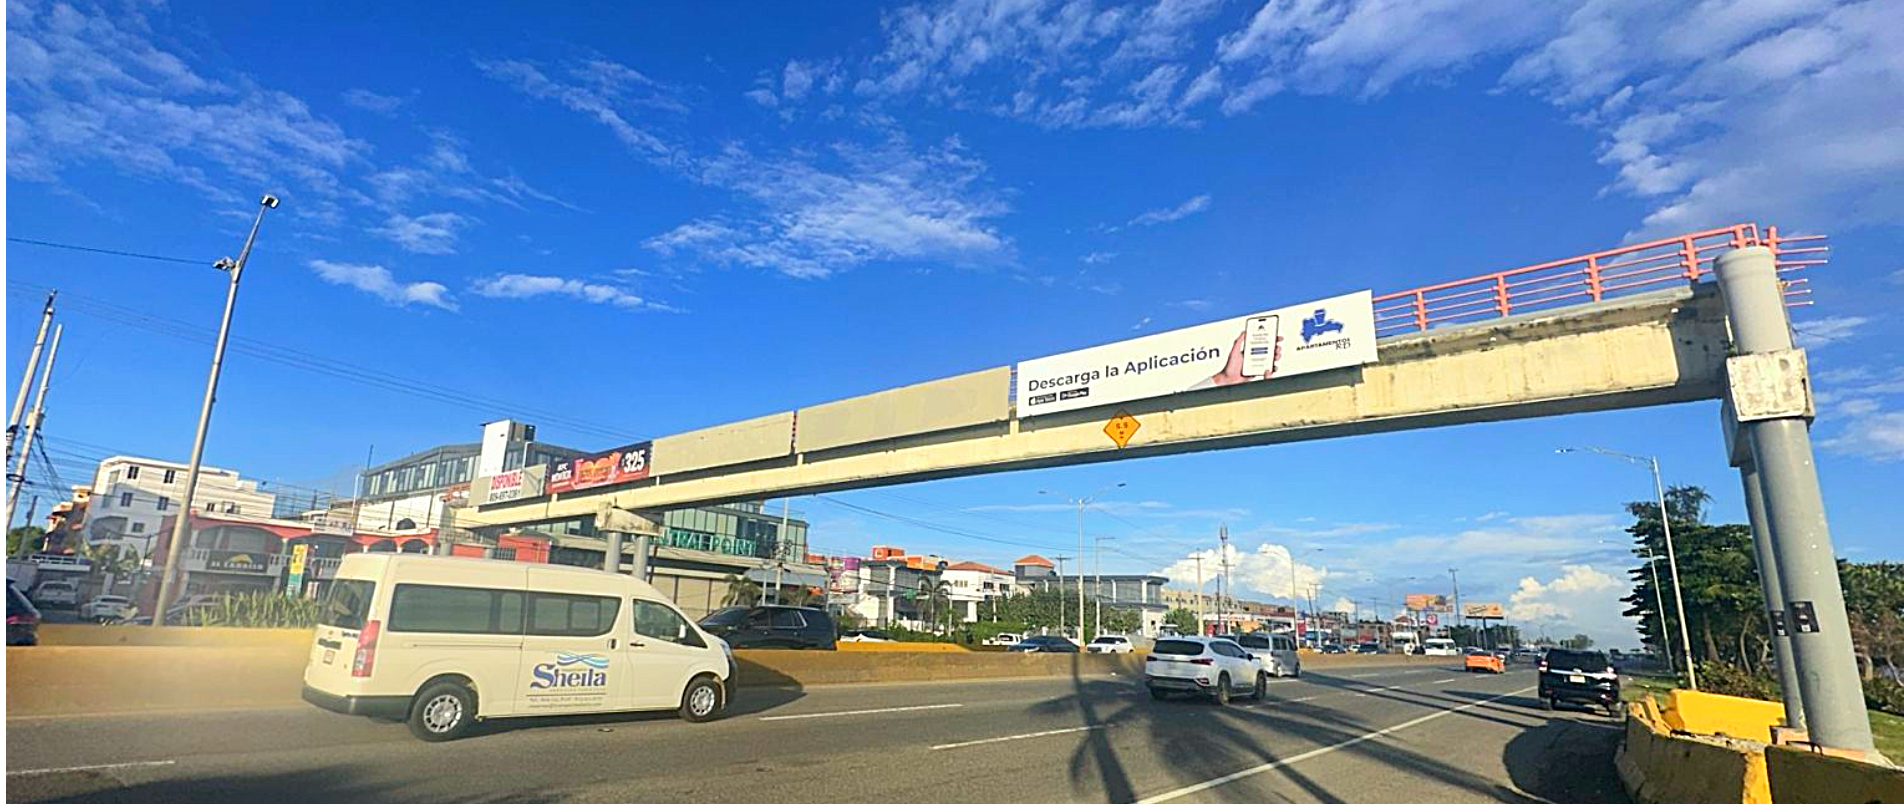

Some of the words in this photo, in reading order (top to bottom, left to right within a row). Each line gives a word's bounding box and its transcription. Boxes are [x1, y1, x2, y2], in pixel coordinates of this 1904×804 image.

[1296, 338, 1350, 351] APARTAMENTOS
[1028, 370, 1100, 392] Descarga
[1105, 365, 1119, 378] la
[1124, 345, 1220, 375] Aplicación
[491, 470, 522, 489] DISPONIBLE
[709, 534, 757, 557] POINT
[530, 663, 606, 689] Sheila
